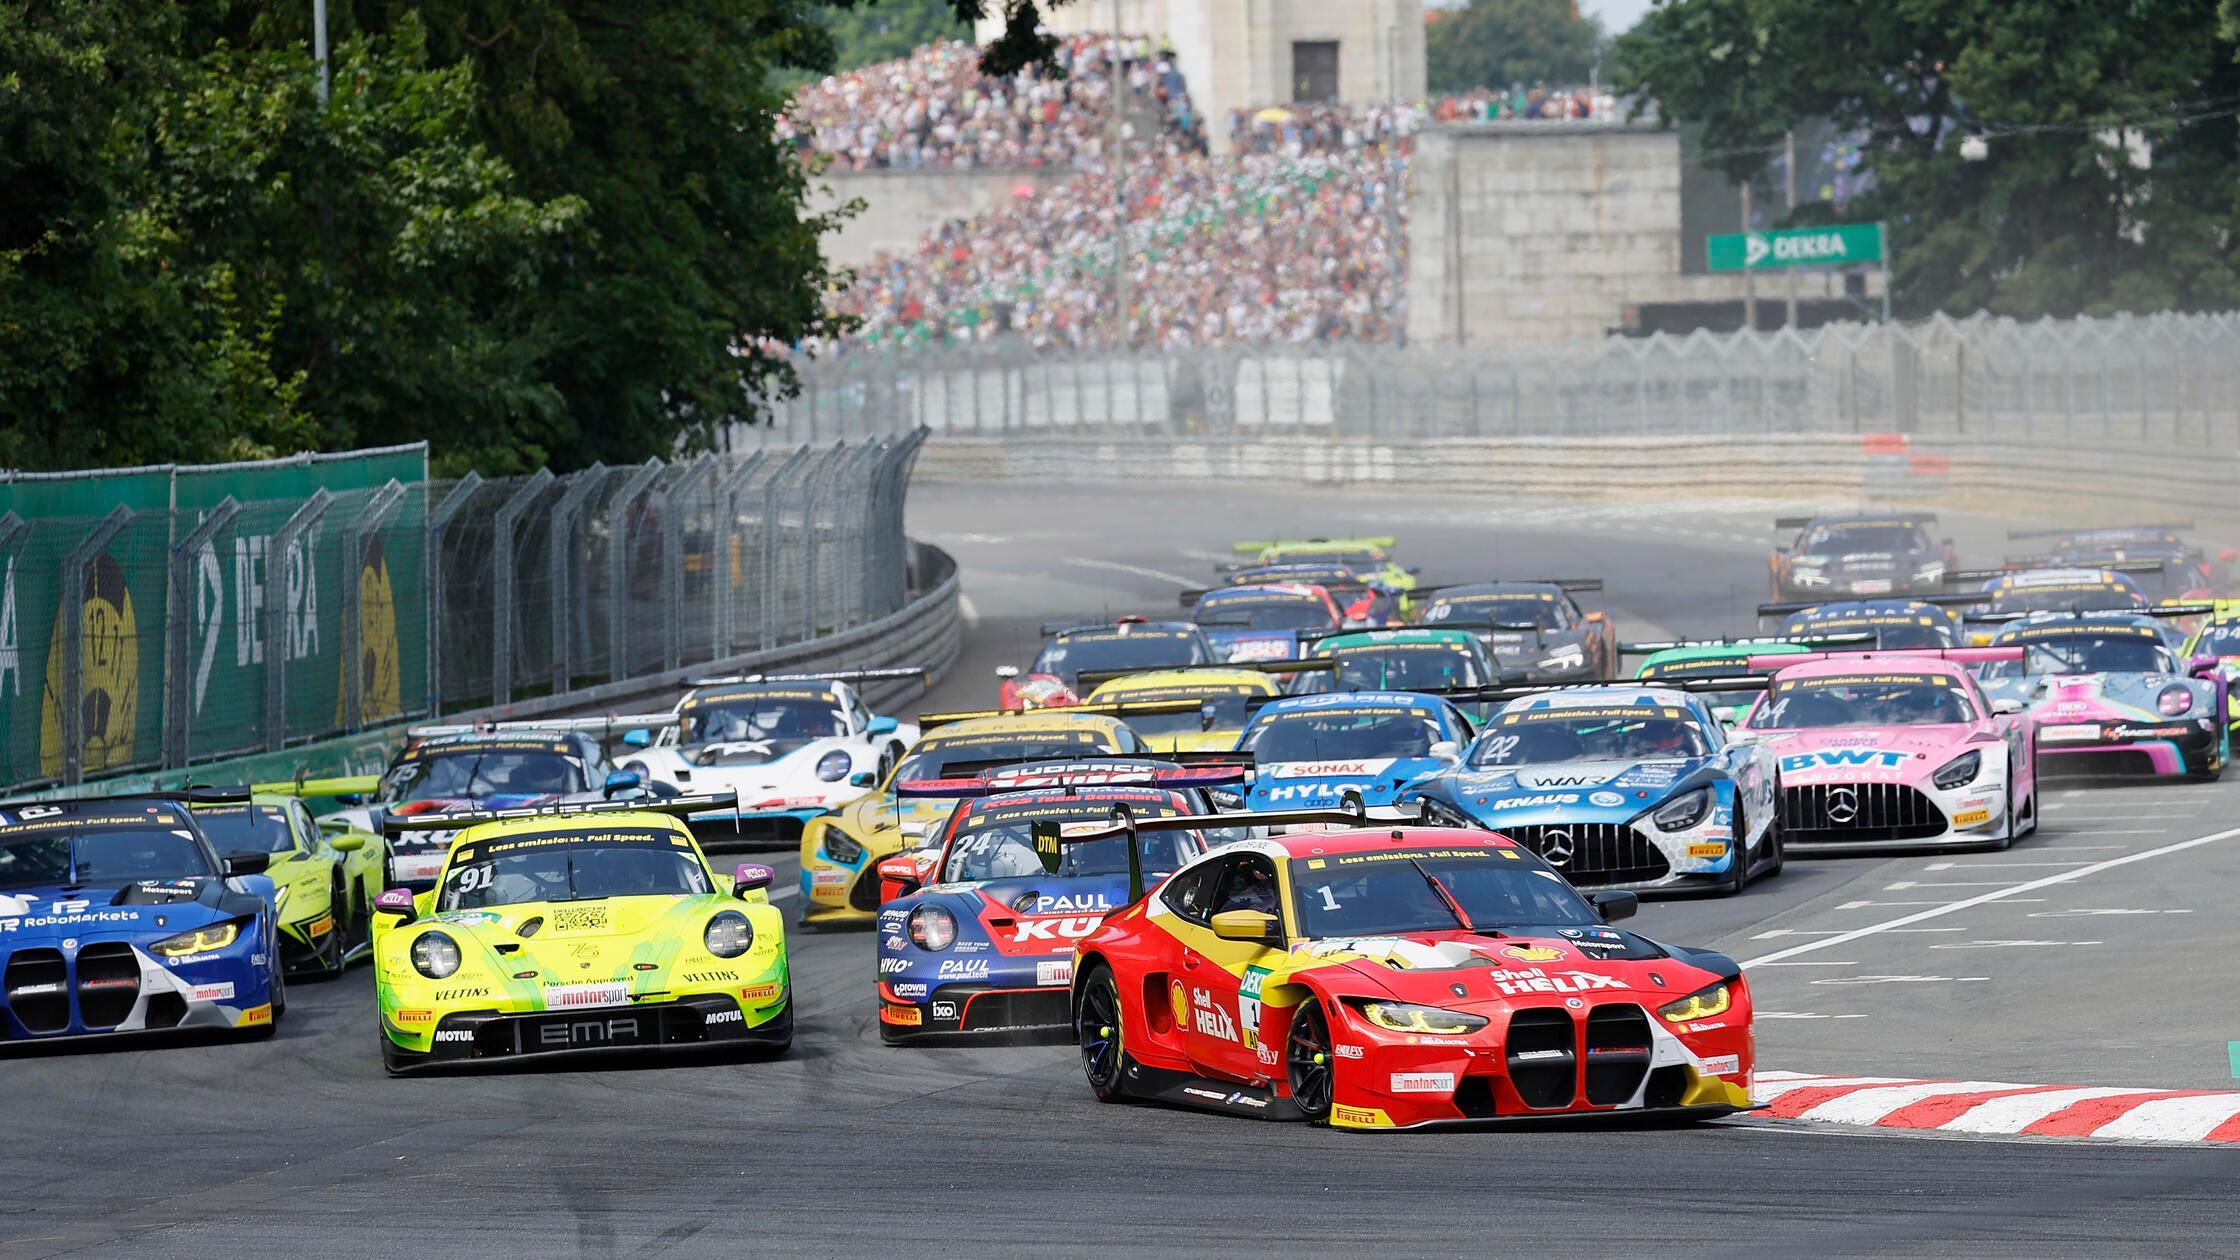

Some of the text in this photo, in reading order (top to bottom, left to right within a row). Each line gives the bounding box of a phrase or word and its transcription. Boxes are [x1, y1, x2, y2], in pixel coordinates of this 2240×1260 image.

[1773, 233, 1847, 259] DEKRA
[236, 531, 319, 666] DERA
[1782, 749, 1911, 774] BWT
[1293, 764, 1366, 776] SONAX
[1793, 771, 1905, 784] ANDGRAF
[1493, 794, 1580, 810] KNAUS
[995, 812, 1020, 820] Less
[1, 816, 146, 833] Less emissions. Full Speed.
[488, 844, 515, 853] Less
[587, 834, 612, 843] Full
[614, 834, 655, 843] Speed.
[952, 832, 992, 857] 24
[1038, 836, 1057, 855] DTM
[1339, 850, 1489, 864] Less emissions. Full Speed.
[459, 865, 493, 893] 91
[142, 886, 192, 896] Motorsport
[1317, 885, 1342, 912] 1
[1037, 894, 1112, 912] PAUL
[25, 911, 139, 927] RoboMarkets
[1013, 917, 1104, 943] KÜ
[1572, 940, 1626, 950] Motorsport
[880, 958, 907, 974] HYLO
[940, 960, 990, 974] PAUL
[1491, 967, 1546, 981] Shell
[543, 975, 634, 987] Porsche Approved
[683, 971, 739, 983] VELTINS
[938, 971, 988, 980] www.paul.tech
[1495, 971, 1631, 995] HELIX
[435, 987, 490, 1001] VELTINS
[562, 987, 629, 1005] motorsport
[742, 985, 775, 999] PIRELLI
[1193, 987, 1211, 1009] Shell
[399, 1010, 432, 1022] PIRELLI
[705, 1010, 743, 1024] MOTUL
[933, 1001, 953, 1017] ixo
[1250, 1002, 1260, 1028] 1
[540, 1018, 639, 1044] EMA
[1195, 1004, 1239, 1043] HELIX
[436, 1030, 475, 1042] MOTUL
[1335, 1044, 1365, 1058] ENDLESS
[1403, 1074, 1453, 1091] motorsport
[1337, 1107, 1376, 1124] PIRELLI
